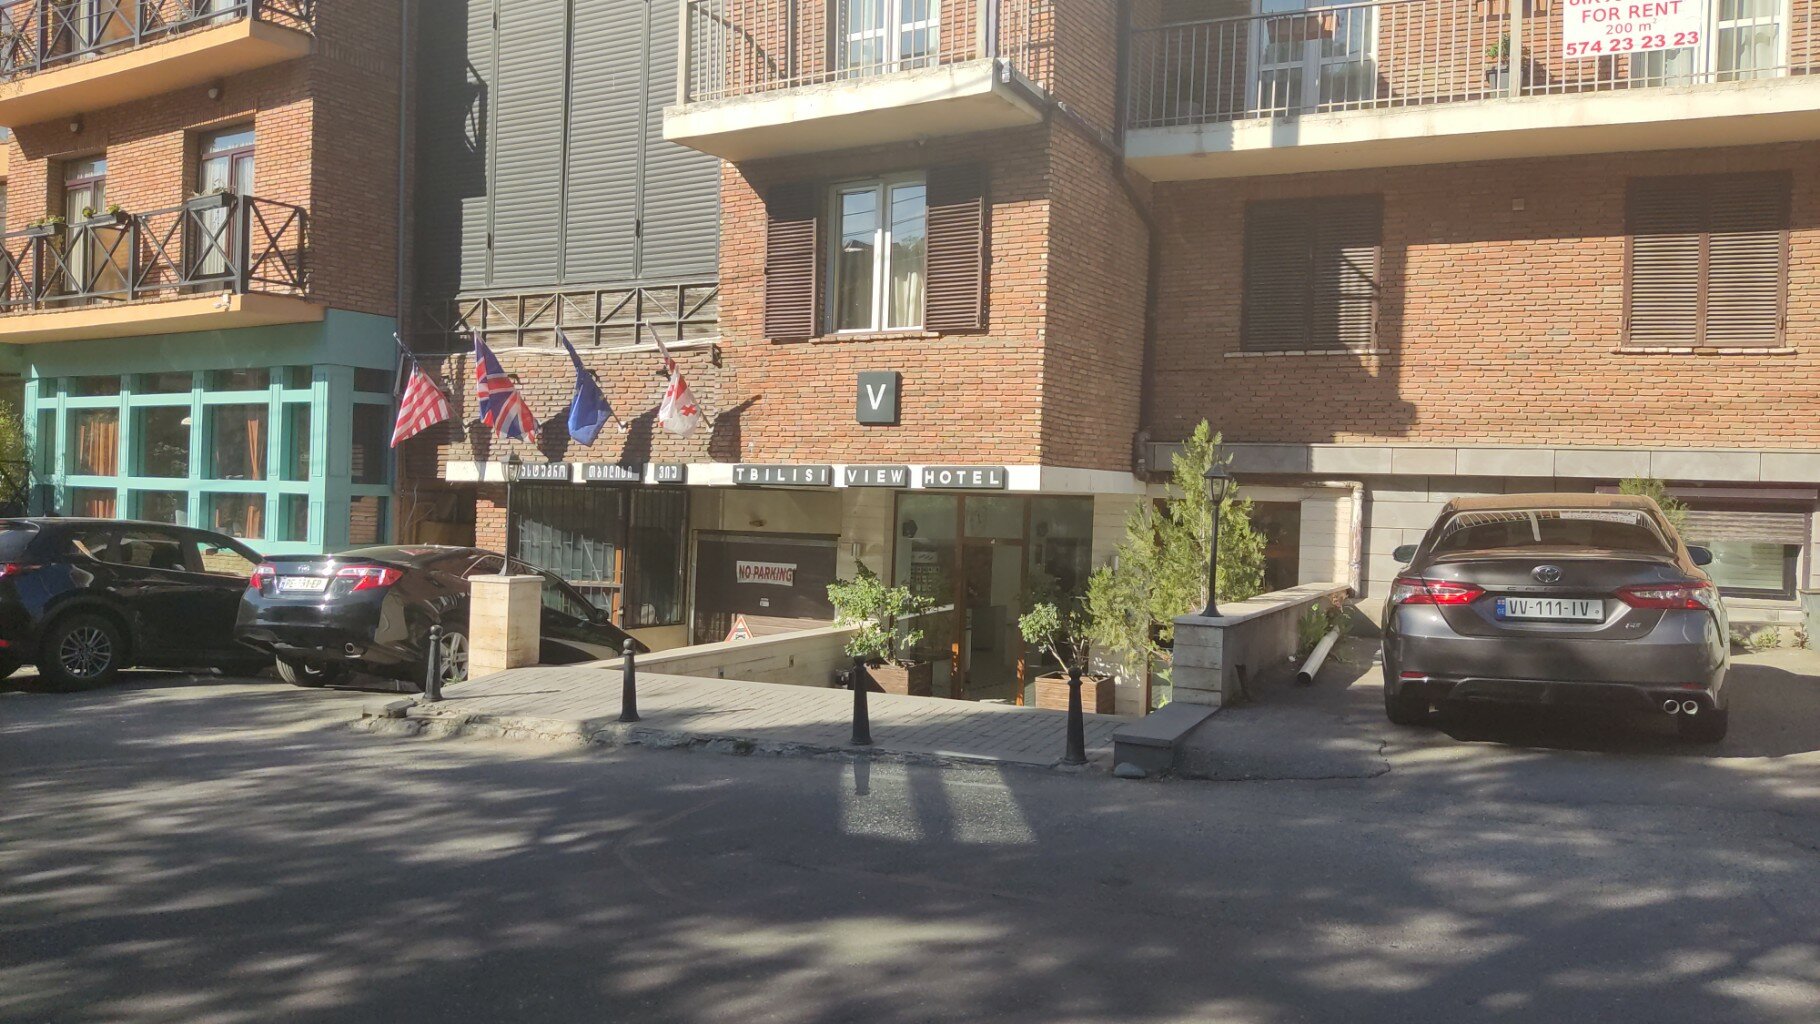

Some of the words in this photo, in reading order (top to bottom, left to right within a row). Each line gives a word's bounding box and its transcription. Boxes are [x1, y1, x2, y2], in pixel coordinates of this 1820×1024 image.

[1581, 7, 1621, 23] FOR
[1628, 1, 1684, 19] RENT
[1606, 22, 1633, 35] 200
[1566, 40, 1602, 56] 574
[1609, 37, 1634, 52] 23
[1641, 34, 1666, 49] 23
[1673, 31, 1699, 46] 23
[865, 383, 887, 410] V
[518, 464, 566, 478] ასტუმრო
[588, 464, 633, 479] თბილისი
[658, 465, 678, 479] ვიუ
[736, 467, 826, 482] TBILISI
[847, 468, 903, 483] VIEW
[924, 469, 999, 485] HOTEL
[739, 565, 752, 579] NO
[753, 565, 793, 582] PARKING
[1508, 600, 1590, 617] VV-111-IV
